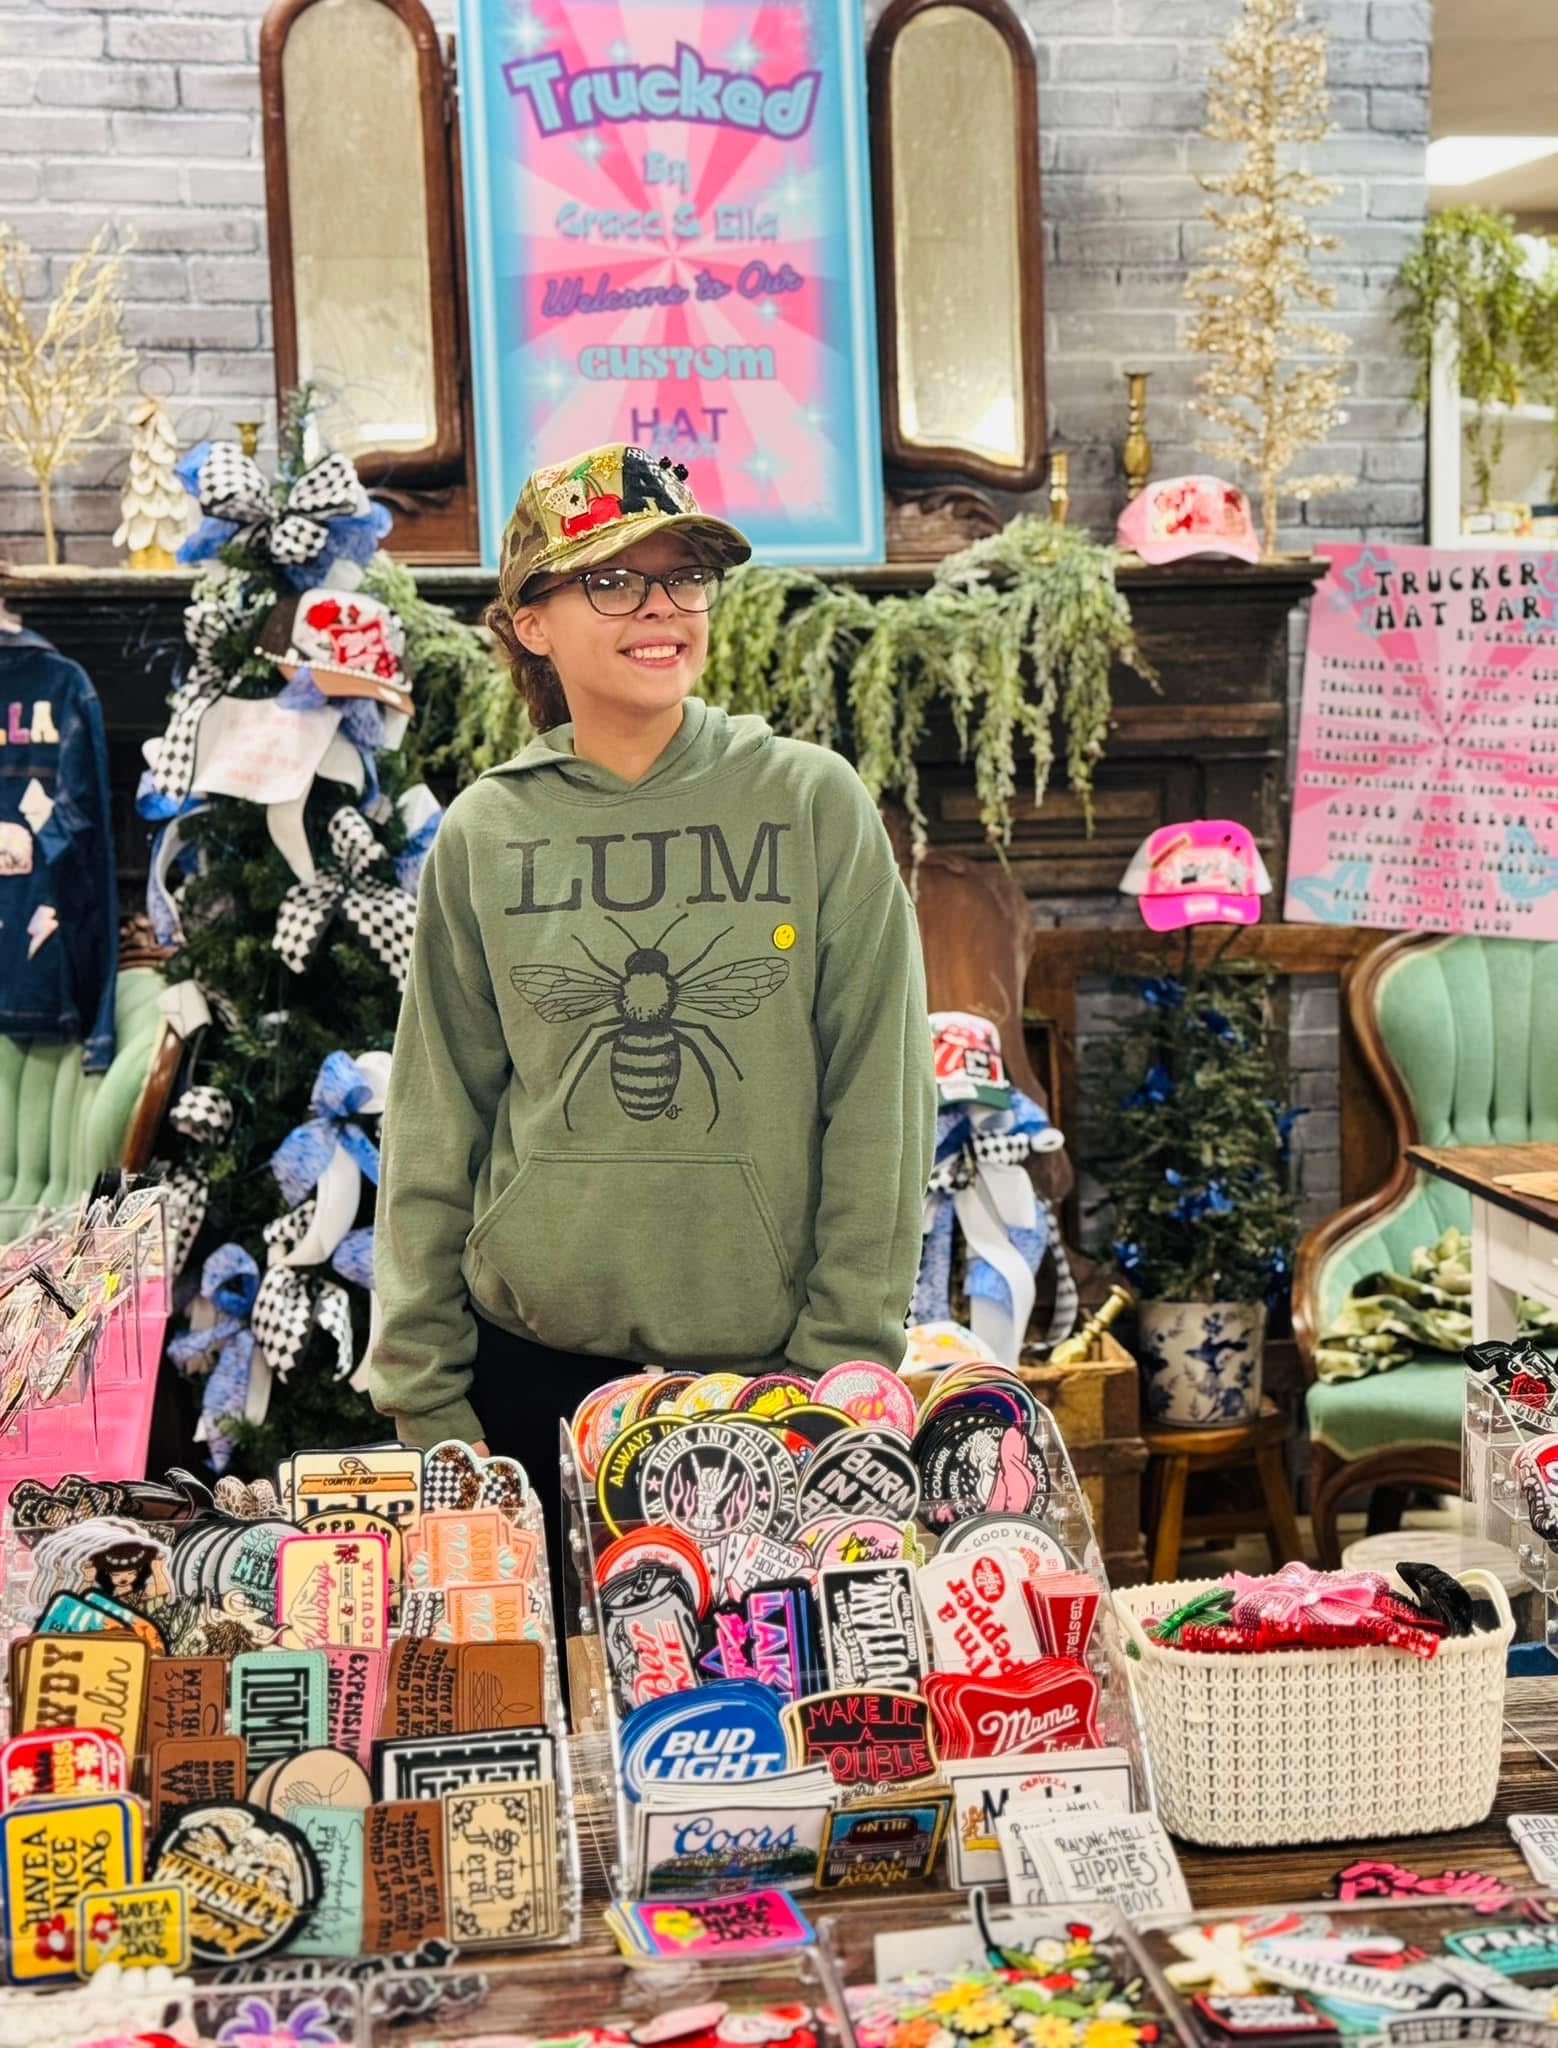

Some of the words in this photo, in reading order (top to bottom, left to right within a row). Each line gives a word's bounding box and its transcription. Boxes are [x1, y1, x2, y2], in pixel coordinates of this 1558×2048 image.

[503, 41, 822, 139] Trucked
[643, 151, 690, 194] By
[542, 275, 688, 317] Welcome
[695, 271, 731, 300] to
[736, 260, 804, 298] Our
[632, 407, 728, 443] HAT
[1374, 561, 1541, 597] TRUCKER
[1374, 603, 1449, 631] HAT
[1469, 595, 1542, 624] BAR
[504, 822, 791, 915] LUM
[609, 1429, 653, 1488] ALWAYS
[653, 1431, 694, 1471] ROCK
[696, 1427, 732, 1446] AND
[735, 1437, 768, 1481] ROLL
[932, 1446, 952, 1500] COWGIRL
[817, 1469, 859, 1503] IN
[840, 1449, 917, 1512] BORN
[760, 1540, 799, 1569] TEXAS
[972, 1527, 1009, 1549] GOOD
[1014, 1528, 1049, 1554] YEAR
[752, 1555, 786, 1583] HOLD
[361, 1558, 374, 1643] EQUILA
[902, 1593, 913, 1619] Deep
[937, 1602, 957, 1623] a
[749, 1590, 795, 1703] LAK
[832, 1590, 865, 1678] American
[850, 1577, 917, 1693] OUTLAW
[908, 1620, 920, 1662] Country
[947, 1578, 1026, 1678] Pepper
[397, 1637, 422, 1692] CHOOSE
[415, 1652, 430, 1682] BUT
[425, 1646, 448, 1702] CHOOSE
[413, 1688, 426, 1719] DAD
[438, 1665, 457, 1715] DADDY
[808, 1697, 881, 1725] MAKE
[893, 1700, 918, 1724] IT
[978, 1702, 1078, 1755] Mama
[661, 1727, 756, 1756] BUD
[648, 1753, 781, 1780] LIGHT
[807, 1743, 933, 1781] DOUBLE
[1019, 1774, 1067, 1792] CERVEZA
[21, 1827, 48, 1847] A
[370, 1806, 389, 1865] CHOOSE
[386, 1821, 401, 1852] BUT
[401, 1810, 418, 1871] CHOOSE
[673, 1816, 799, 1855] Coors
[856, 1821, 882, 1832] ON
[1055, 1830, 1108, 1858] RAISING
[1109, 1824, 1145, 1843] HELL
[391, 1855, 406, 1887] DAD
[417, 1827, 434, 1878] DADDY
[462, 1825, 496, 1907] Feral
[494, 1827, 521, 1901] Stay
[1069, 1852, 1158, 1891] HIPPIES
[20, 1850, 50, 1933] HAVE
[52, 1836, 78, 1909] NICE
[404, 1873, 420, 1904] CAN
[839, 1871, 909, 1887] AGAIN
[109, 1901, 160, 1920] HAVE
[161, 1899, 173, 1915] A
[157, 1853, 297, 1937] WHISKEY
[373, 1870, 391, 1918] CAN'T
[394, 1891, 411, 1932] YOUR
[423, 1885, 441, 1923] YOUR
[676, 1899, 754, 1918] HAVE
[755, 1896, 773, 1910] A
[121, 1919, 166, 1938] NICE
[376, 1925, 391, 1949] YOU
[408, 1915, 425, 1940] YOU
[703, 1912, 770, 1931] NICE
[711, 1926, 784, 1945] DAY
[119, 1941, 168, 1962] DAY
